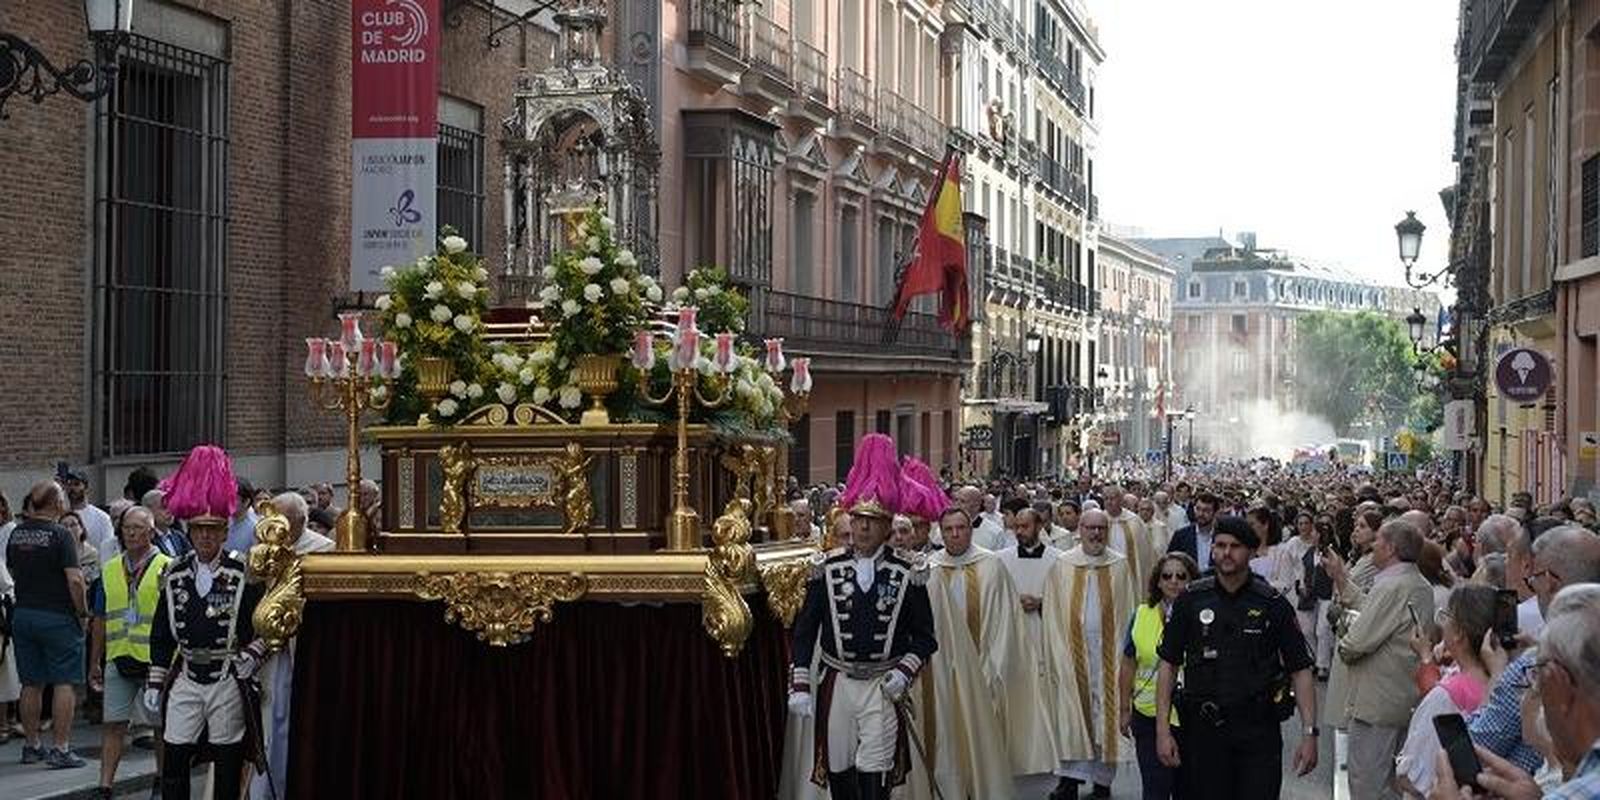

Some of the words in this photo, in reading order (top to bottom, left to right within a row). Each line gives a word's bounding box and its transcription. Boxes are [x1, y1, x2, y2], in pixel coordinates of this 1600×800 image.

[362, 11, 405, 26] CLUB
[362, 31, 383, 45] DE
[362, 49, 426, 63] MADRID
